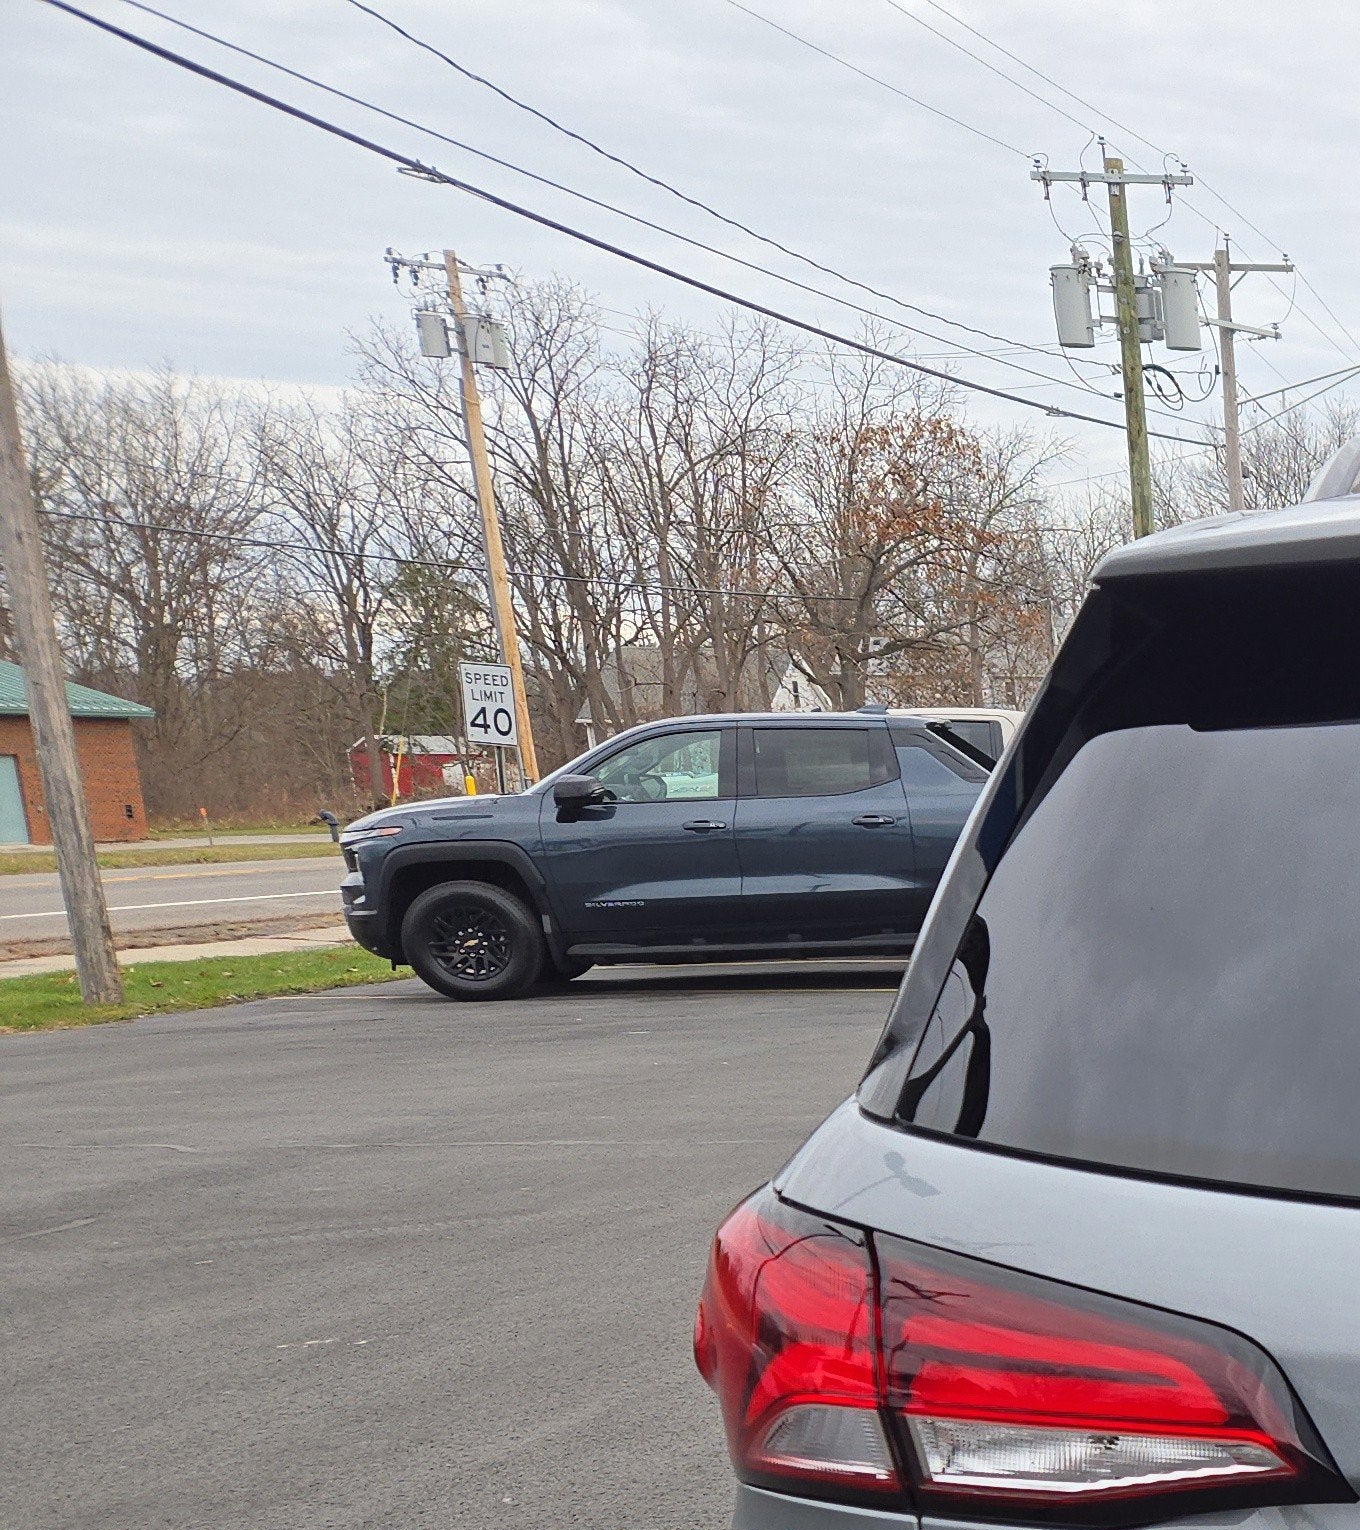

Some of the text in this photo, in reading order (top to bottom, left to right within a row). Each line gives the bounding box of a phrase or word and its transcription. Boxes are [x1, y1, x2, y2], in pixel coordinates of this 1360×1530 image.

[465, 672, 508, 687] SPEED
[471, 689, 505, 703] LIMIT
[470, 706, 512, 736] 40
